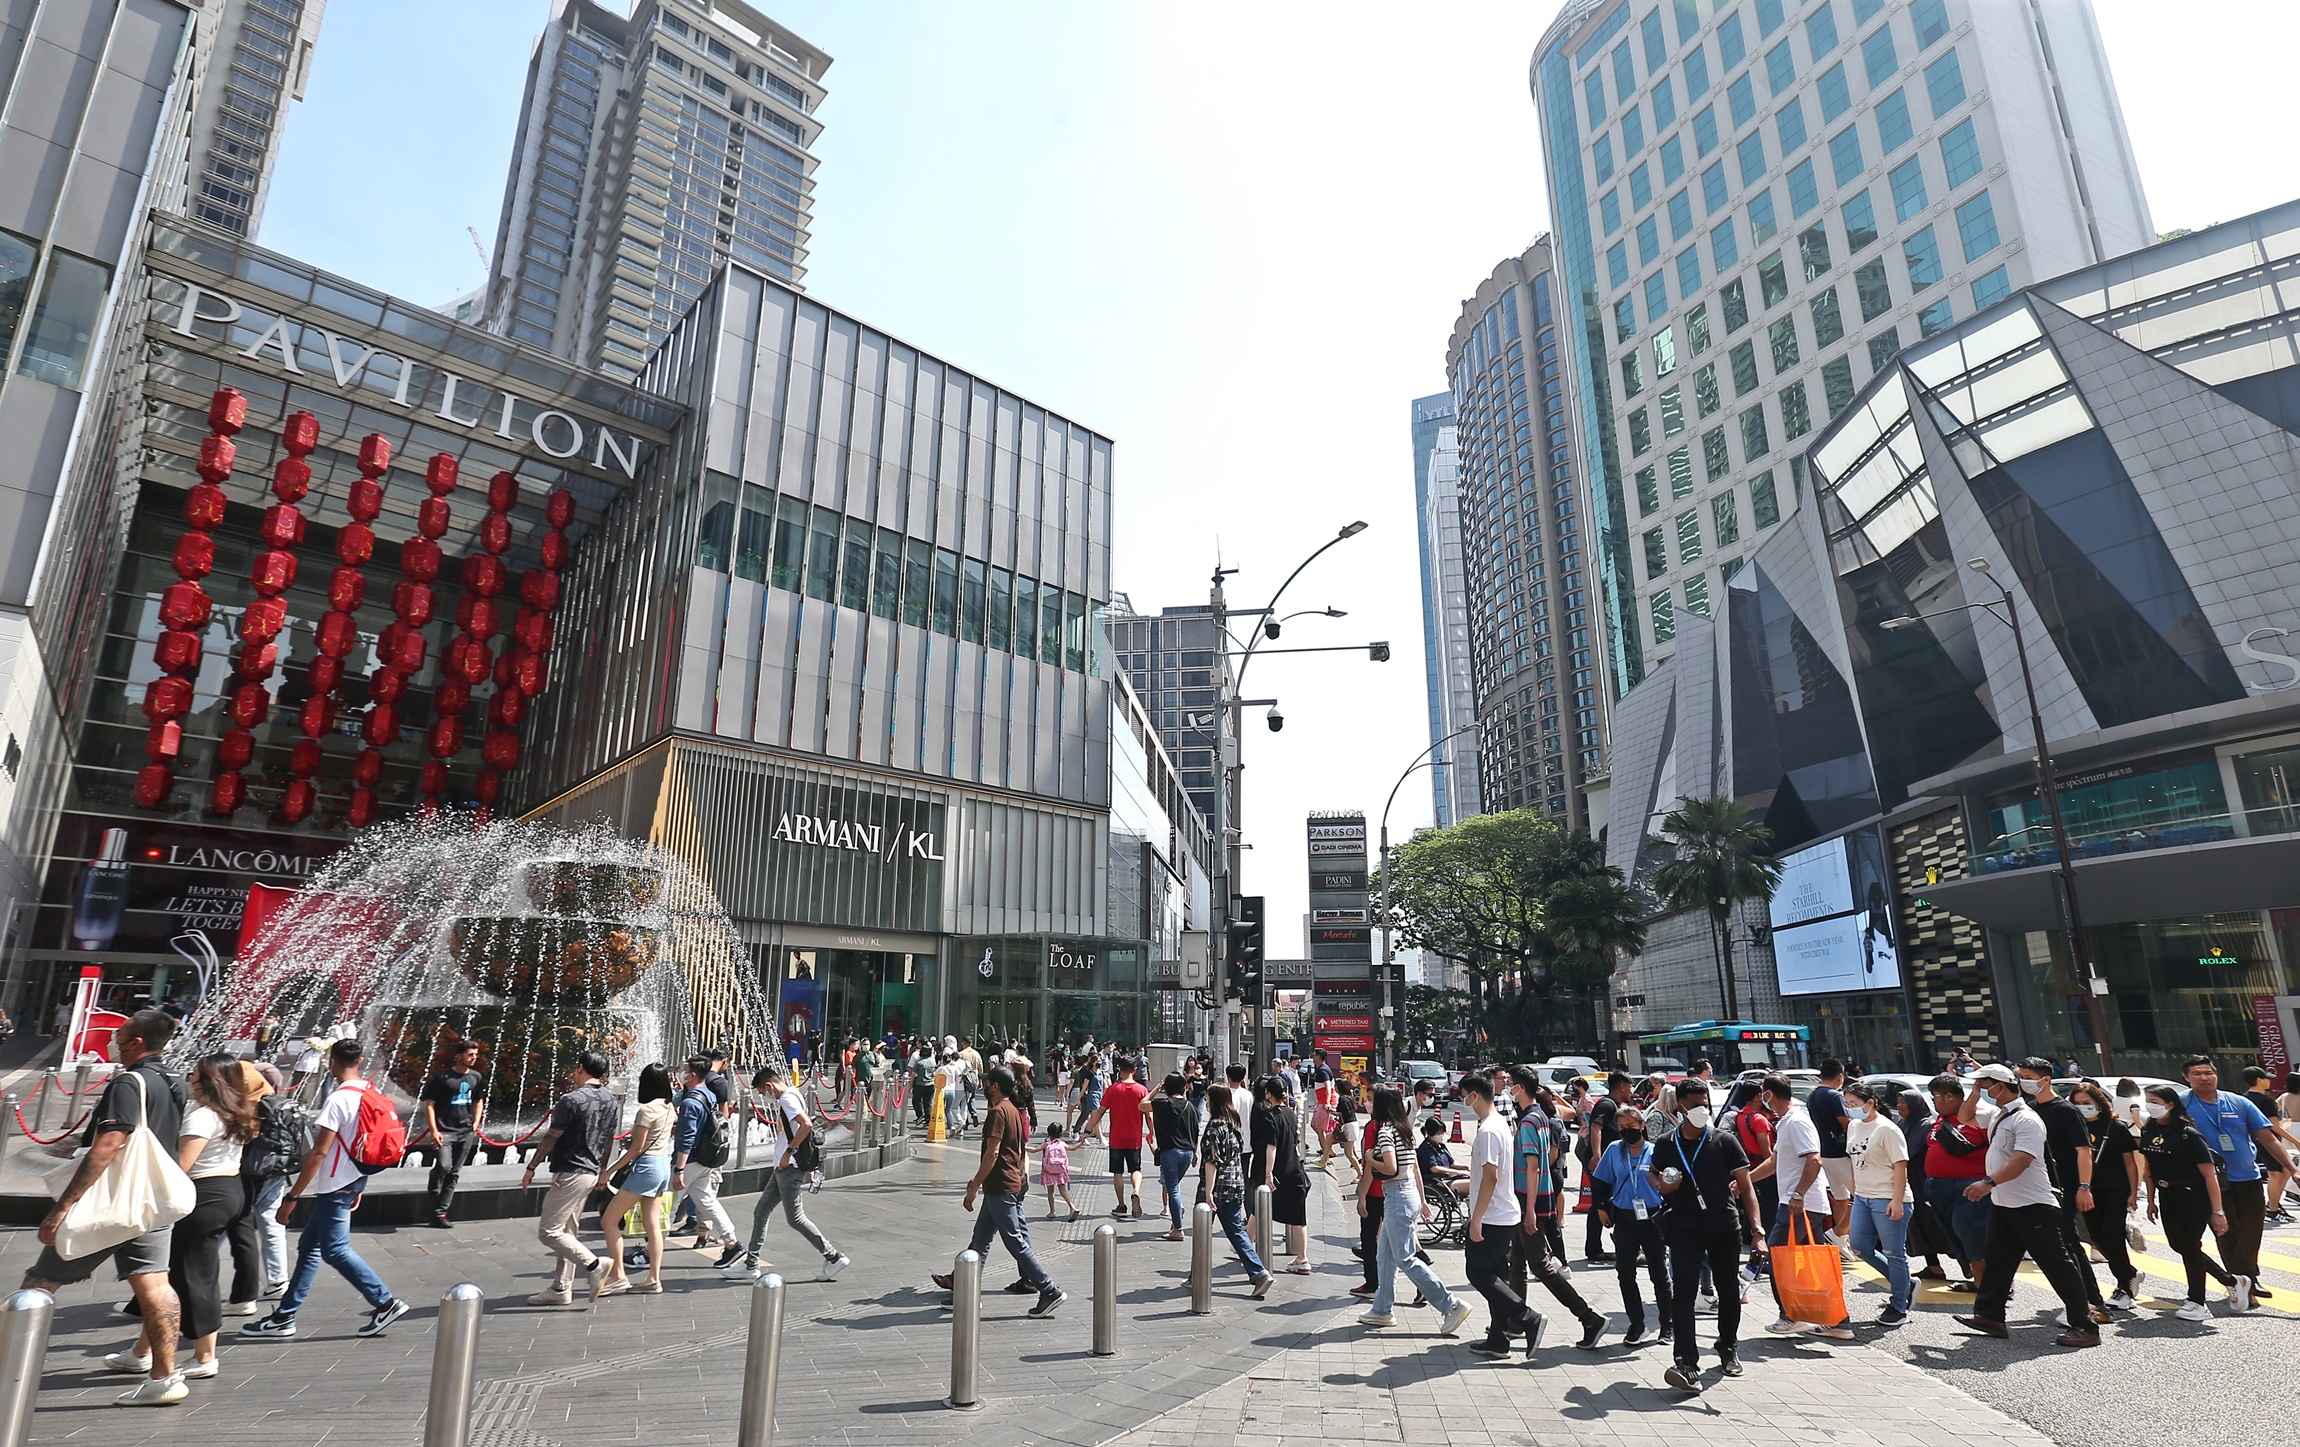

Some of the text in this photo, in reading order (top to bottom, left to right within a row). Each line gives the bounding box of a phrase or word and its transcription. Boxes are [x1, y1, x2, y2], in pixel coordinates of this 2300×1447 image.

[170, 281, 644, 480] PAVILION
[2066, 773, 2106, 789] spectrum
[772, 811, 881, 853] ARMANI
[908, 830, 944, 861] KL
[1309, 827, 1364, 837] PARKSON
[169, 845, 321, 876] LANCÔME
[1325, 875, 1352, 884] PADINI
[187, 885, 228, 896] HAPPY
[1799, 883, 1814, 895] THE
[165, 897, 243, 915] LET'S B
[1792, 891, 1824, 911] STARHILL
[1339, 910, 1364, 918] Norman
[1786, 903, 1835, 924] RECOMMENDS
[838, 936, 864, 946] ARMANI
[871, 938, 881, 946] KL
[1323, 929, 1357, 940] Mercato
[1050, 943, 1065, 953] The
[1804, 941, 1813, 950] INTO
[1813, 940, 1821, 949] THE
[1821, 938, 1831, 947] NEW
[1832, 936, 1844, 945] YEAR
[1049, 952, 1096, 969] LOAF
[2199, 957, 2237, 965] ROLEX
[2258, 1025, 2278, 1075] OPENING
[2268, 1024, 2286, 1065] GRAND
